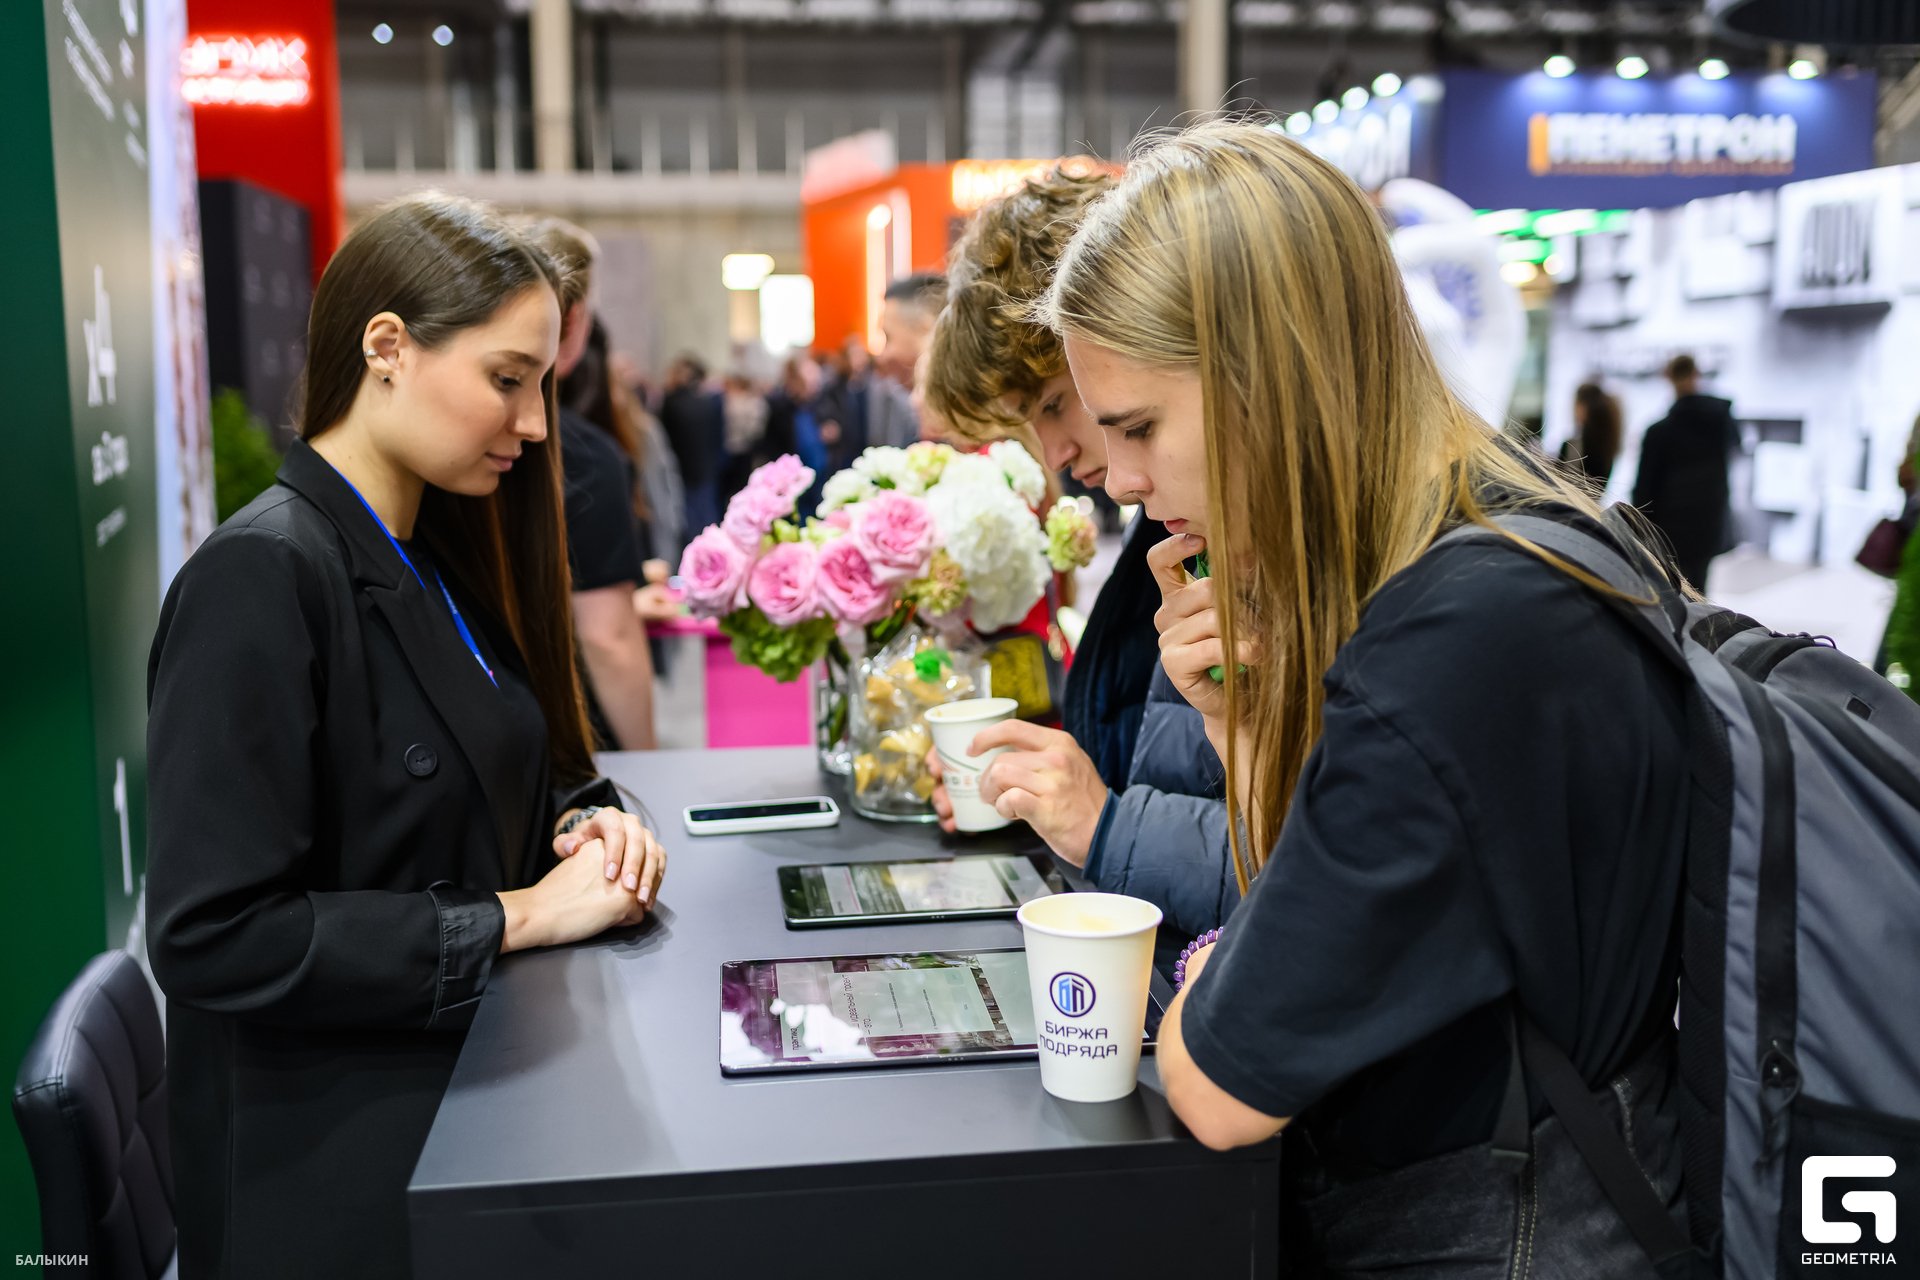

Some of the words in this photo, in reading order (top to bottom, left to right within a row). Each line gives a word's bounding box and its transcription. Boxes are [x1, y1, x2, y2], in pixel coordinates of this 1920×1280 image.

[844, 992, 859, 1023] идеальный
[1045, 1020, 1108, 1040] БИРЖА
[1039, 1033, 1118, 1060] ПОДРЯДА
